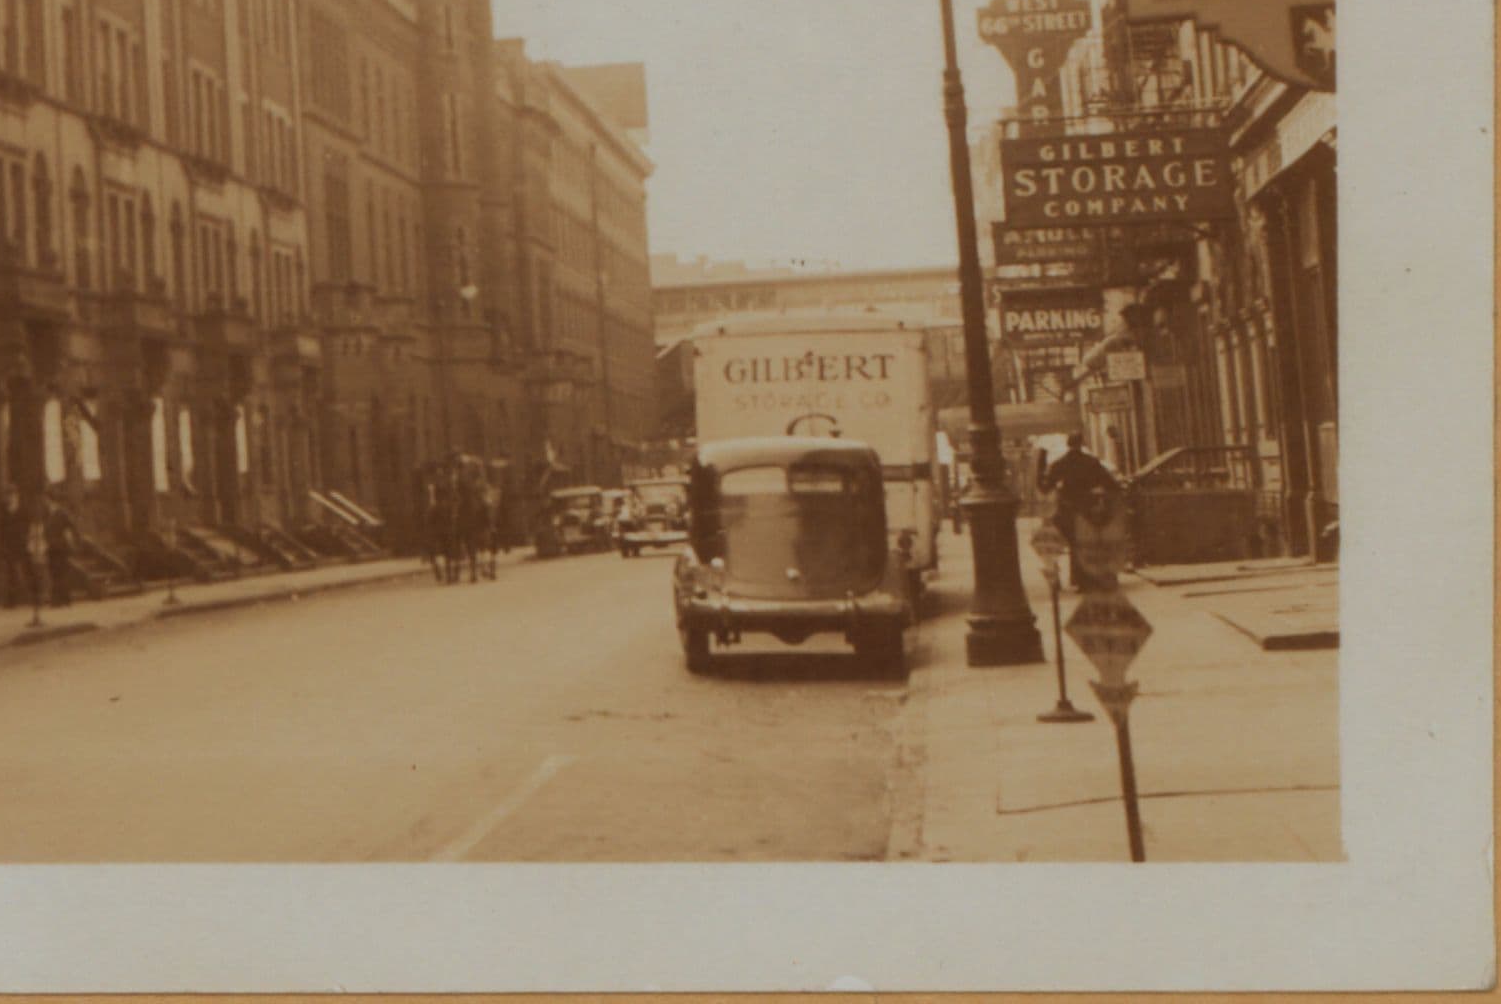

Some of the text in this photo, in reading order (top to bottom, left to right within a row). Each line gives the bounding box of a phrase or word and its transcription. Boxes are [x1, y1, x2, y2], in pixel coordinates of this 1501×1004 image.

[1023, 10, 1086, 32] STREET
[1040, 137, 1186, 162] GILBERT
[1014, 159, 1219, 197] STORAGE
[1044, 196, 1190, 218] COMPANY
[1005, 307, 1100, 332] PARKING
[723, 353, 894, 384] GILBERT
